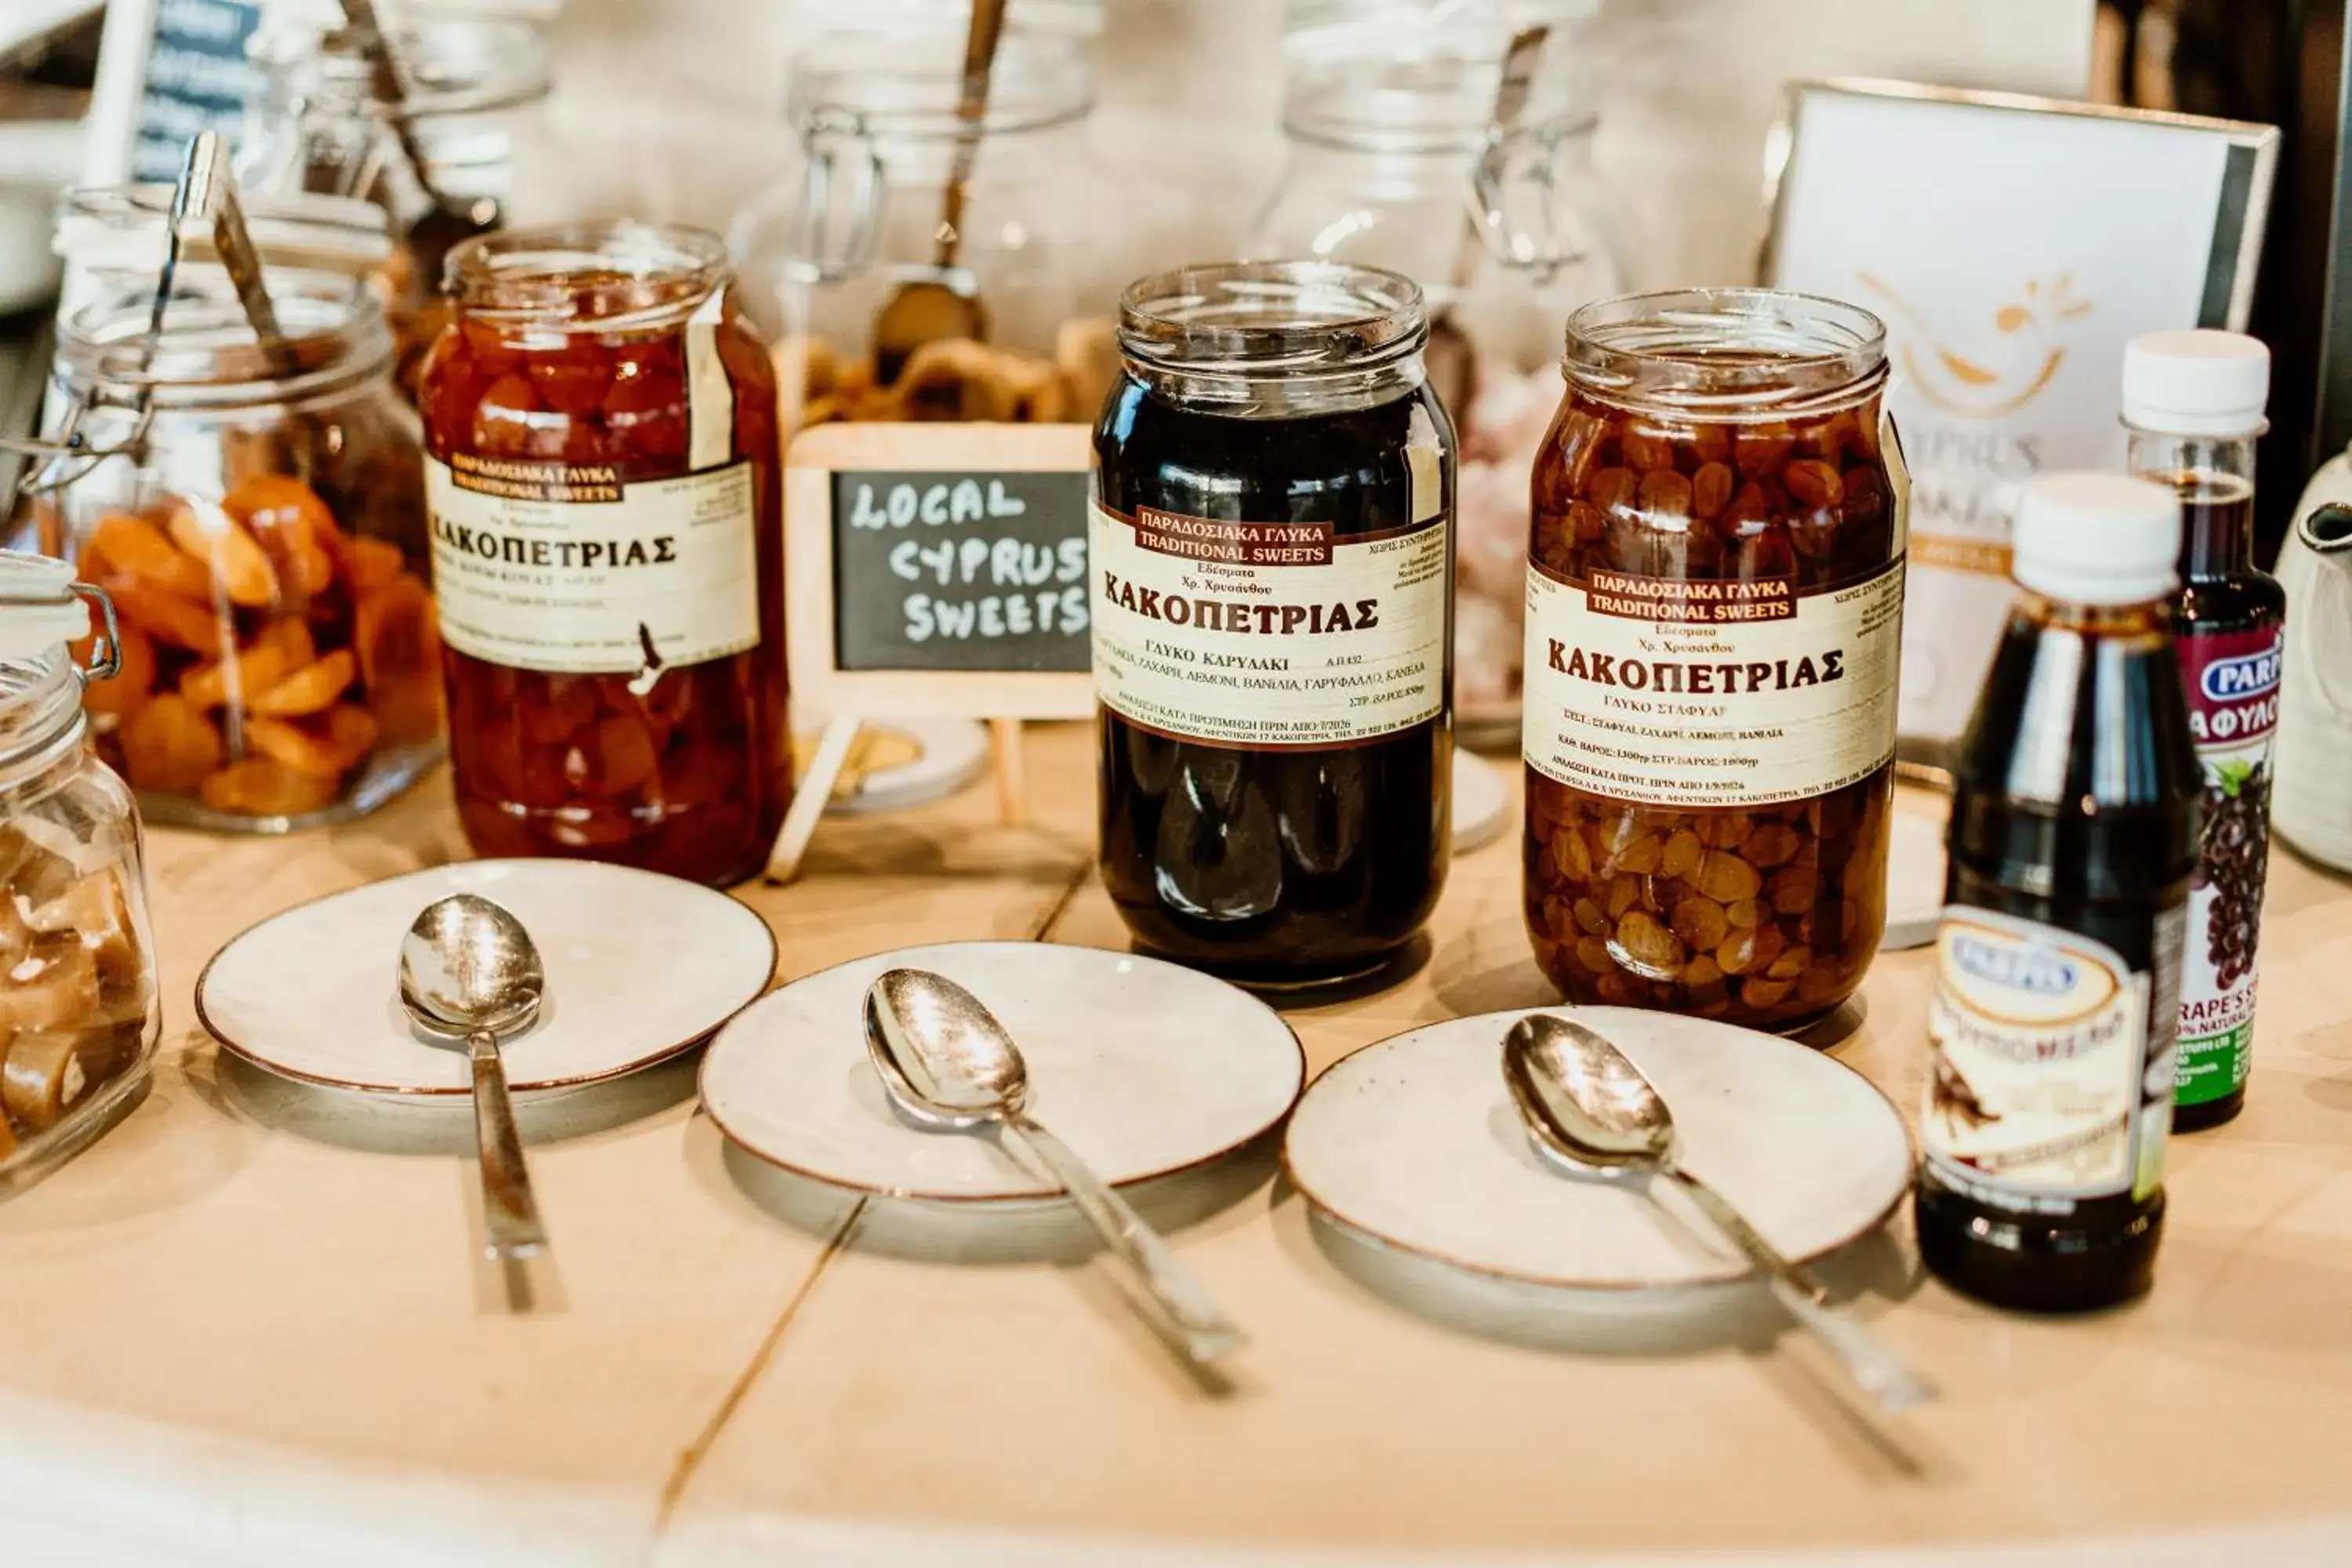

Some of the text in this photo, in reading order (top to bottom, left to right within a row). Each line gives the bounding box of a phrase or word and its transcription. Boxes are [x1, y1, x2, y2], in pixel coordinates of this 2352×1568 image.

[851, 478, 1026, 530] LOCAL
[1142, 512, 1324, 542] ΠΑΡΑΔΟΣΙΑΚΑ ΓΛΥΚΑ
[888, 537, 1087, 586] CYPRUS
[1141, 531, 1325, 562] TRADITIONAL SWEETS
[1181, 576, 1200, 590] Χρ.
[1197, 562, 1255, 578] Εδέσματα
[1592, 574, 1789, 599] ΠΑΡΑΔΟΣΙΑΚΑ ΓΛΥΚΑ
[903, 585, 1089, 642] SWEETS
[1105, 570, 1379, 634] ΚΑΚΟΠΕΤΡΙΑΣ
[1592, 593, 1790, 620] TRADITIONAL SWEETS
[1145, 639, 1196, 662] ΓΛΥΚΟ
[1548, 637, 1844, 694] ΚΑΚΟΠΕΤΡΙΑΣ
[1604, 695, 1652, 713] ΓΛΥΚΟ
